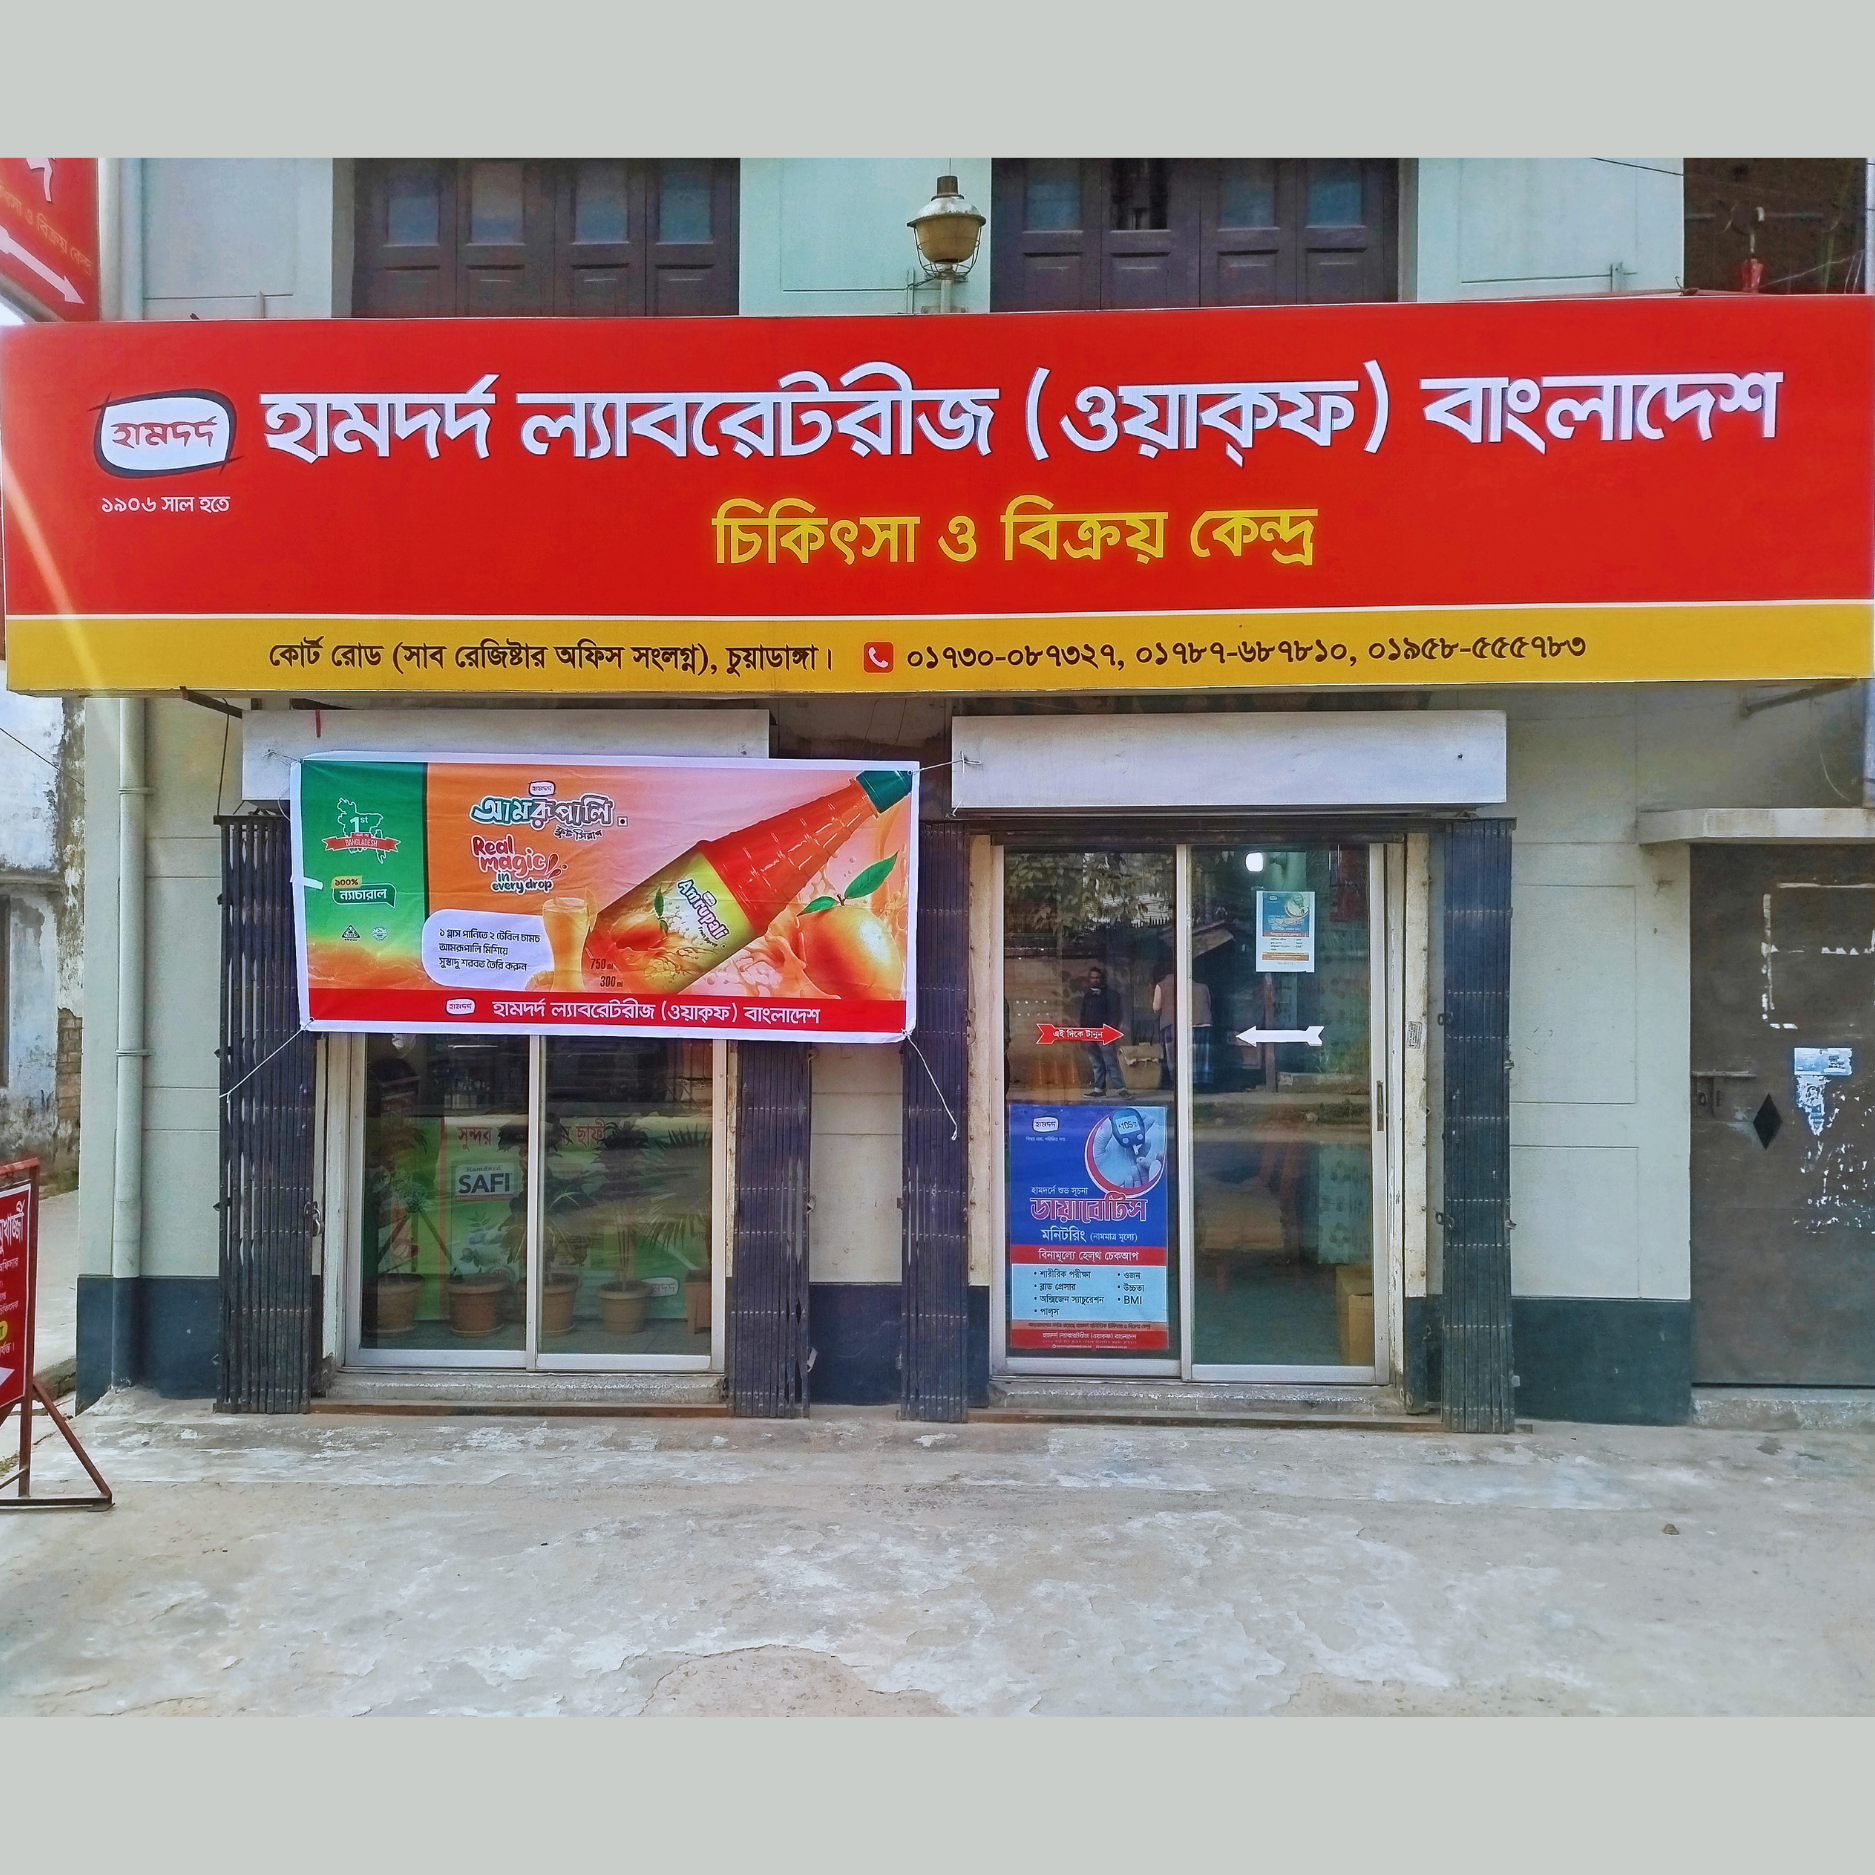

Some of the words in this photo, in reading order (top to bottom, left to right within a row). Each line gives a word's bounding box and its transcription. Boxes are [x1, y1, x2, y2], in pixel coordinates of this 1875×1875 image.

[259, 374, 499, 464] হামদর্দ
[515, 361, 999, 459] ল্যাবরেটরীজ
[1420, 372, 1783, 455] বাংলাদেশ
[110, 416, 218, 449] হামদর্দ
[101, 497, 156, 513] ১৯০৬
[161, 496, 195, 512] সাল
[198, 496, 231, 513] হতে
[711, 497, 920, 565] চিকিৎসা
[938, 515, 977, 563] ও
[1000, 495, 1168, 565] বিক্রয়
[1189, 508, 1318, 566] কেন্দ্র
[269, 636, 324, 668] কোর্ট
[331, 642, 384, 668] রোড
[392, 641, 447, 674] (সাব
[553, 638, 626, 669] অফিস
[1368, 635, 1586, 660] ০১৯৫৮-৫৫৫৭৮৩
[344, 838, 378, 848] BANGLADESH
[472, 834, 514, 856] Real
[496, 870, 512, 882] in
[340, 885, 387, 901] ন্যাচারাল
[492, 880, 524, 894] every
[526, 878, 553, 892] drop
[677, 878, 731, 942] Amrupali
[462, 928, 488, 940] পানিতে
[496, 930, 520, 942] টেবিল
[520, 934, 541, 943] চামচ
[483, 944, 508, 956] মিশিয়ে
[590, 958, 606, 970] 750
[600, 976, 616, 988] 300
[492, 998, 546, 1018] হামদর্দ
[550, 998, 656, 1019] ল্যাবরেটরীজ
[743, 1006, 821, 1025] বাংলাদেশ
[1052, 1030, 1065, 1038] এই
[456, 1126, 492, 1152] সুন্দর
[458, 1172, 510, 1194] SAFI
[1030, 1191, 1148, 1223] ডায়াবেটিস
[1040, 1226, 1086, 1242] মনিটরিং
[1104, 1252, 1139, 1262] চেকআপ
[1124, 1296, 1142, 1304] BMI
